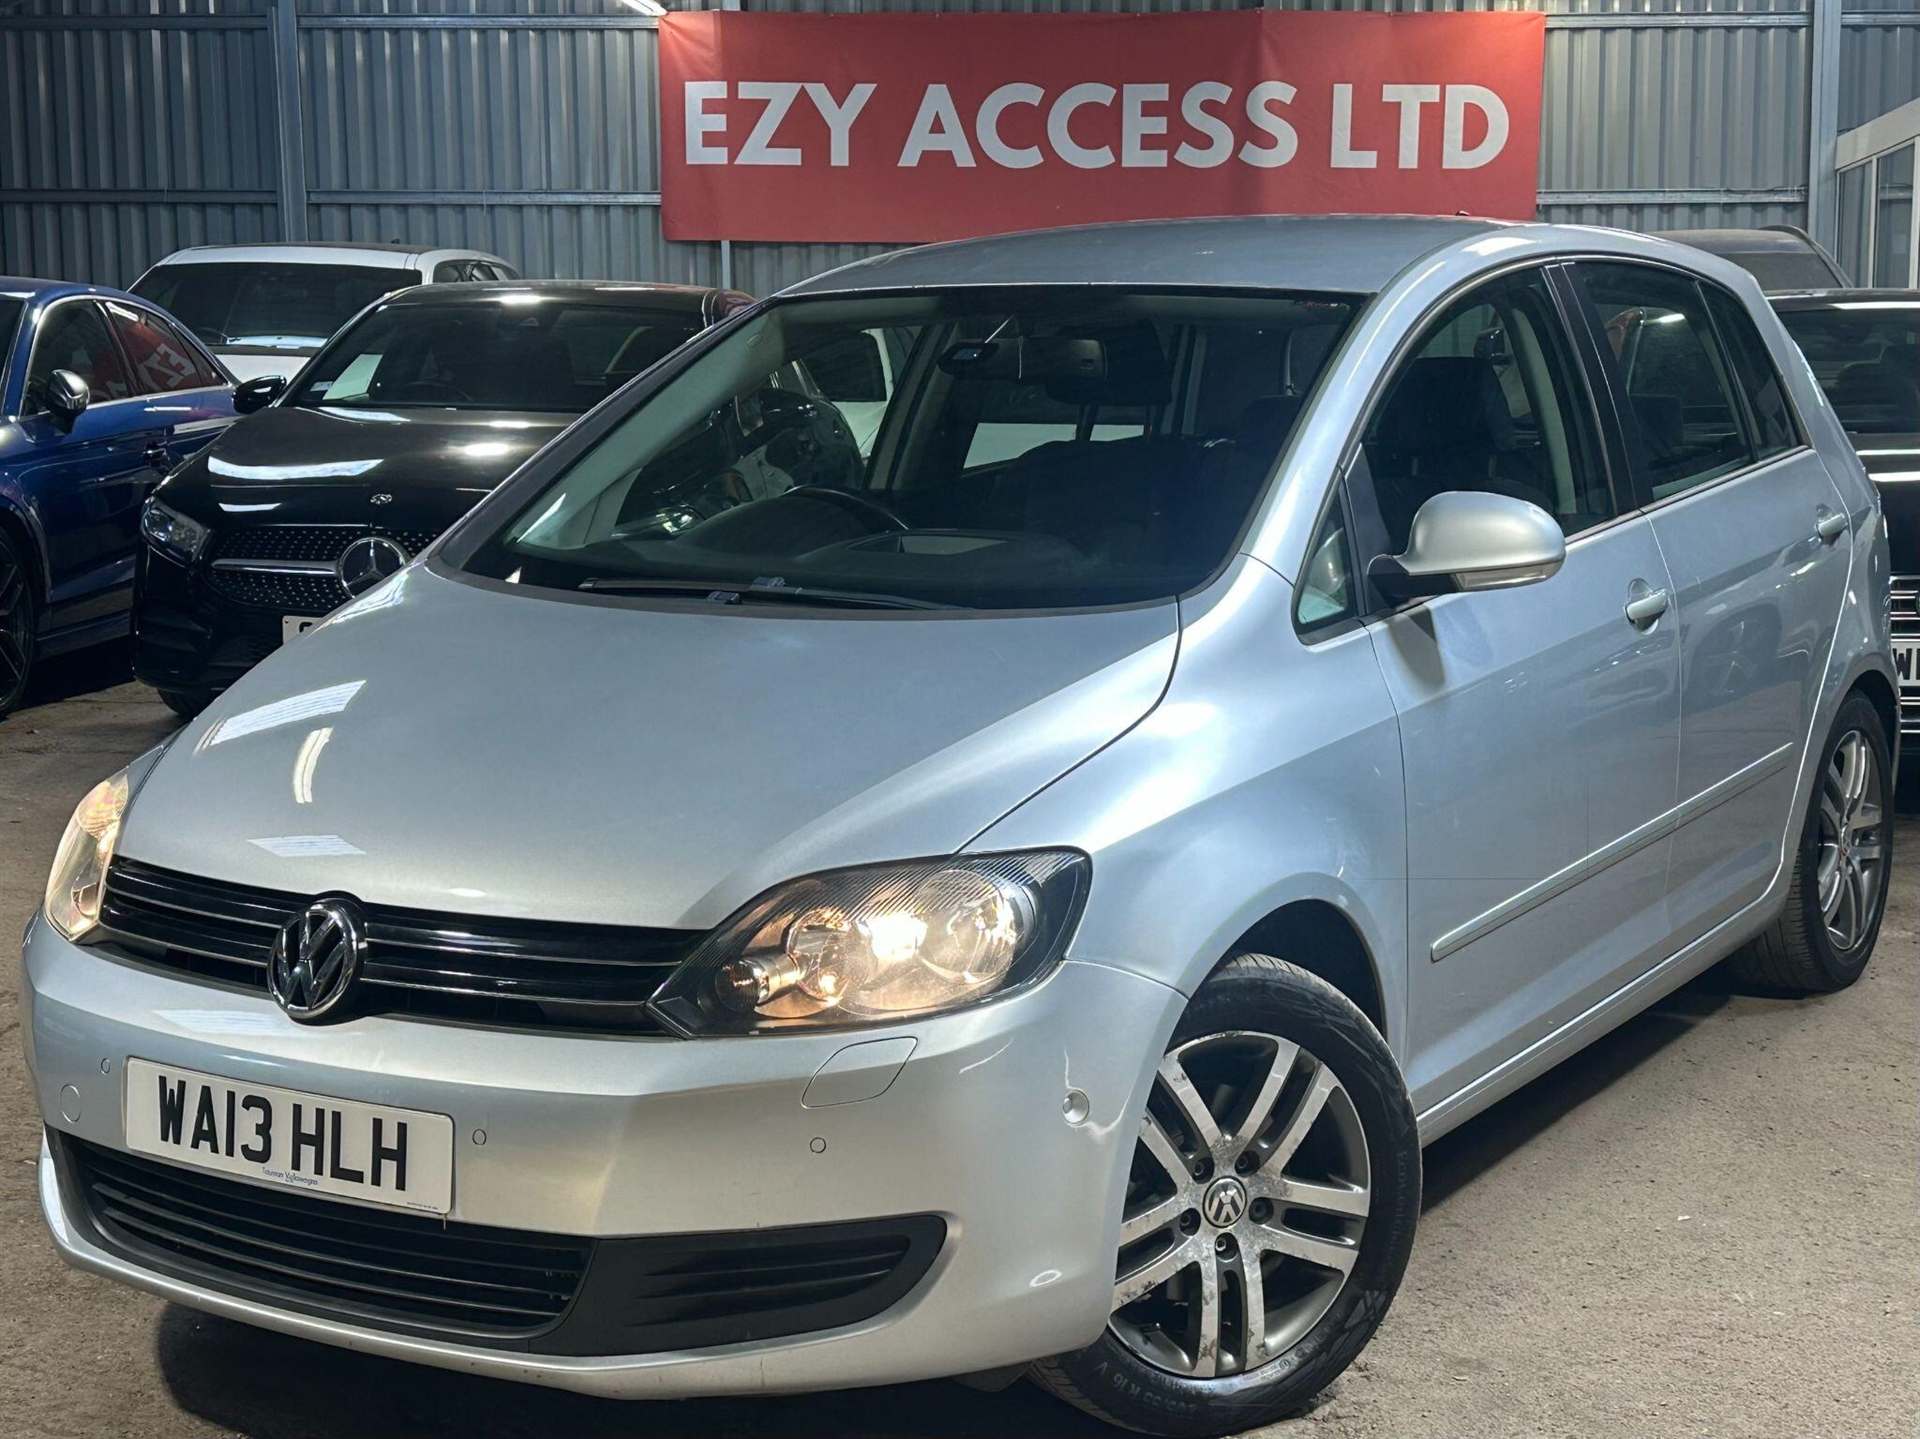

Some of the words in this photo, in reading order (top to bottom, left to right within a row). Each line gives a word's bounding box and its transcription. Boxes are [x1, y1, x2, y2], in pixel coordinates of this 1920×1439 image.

[684, 81, 877, 167] EZY
[897, 81, 1298, 169] ACCESS
[1330, 84, 1511, 169] LTD
[159, 1075, 272, 1164] WA13
[291, 1103, 407, 1191] HLH
